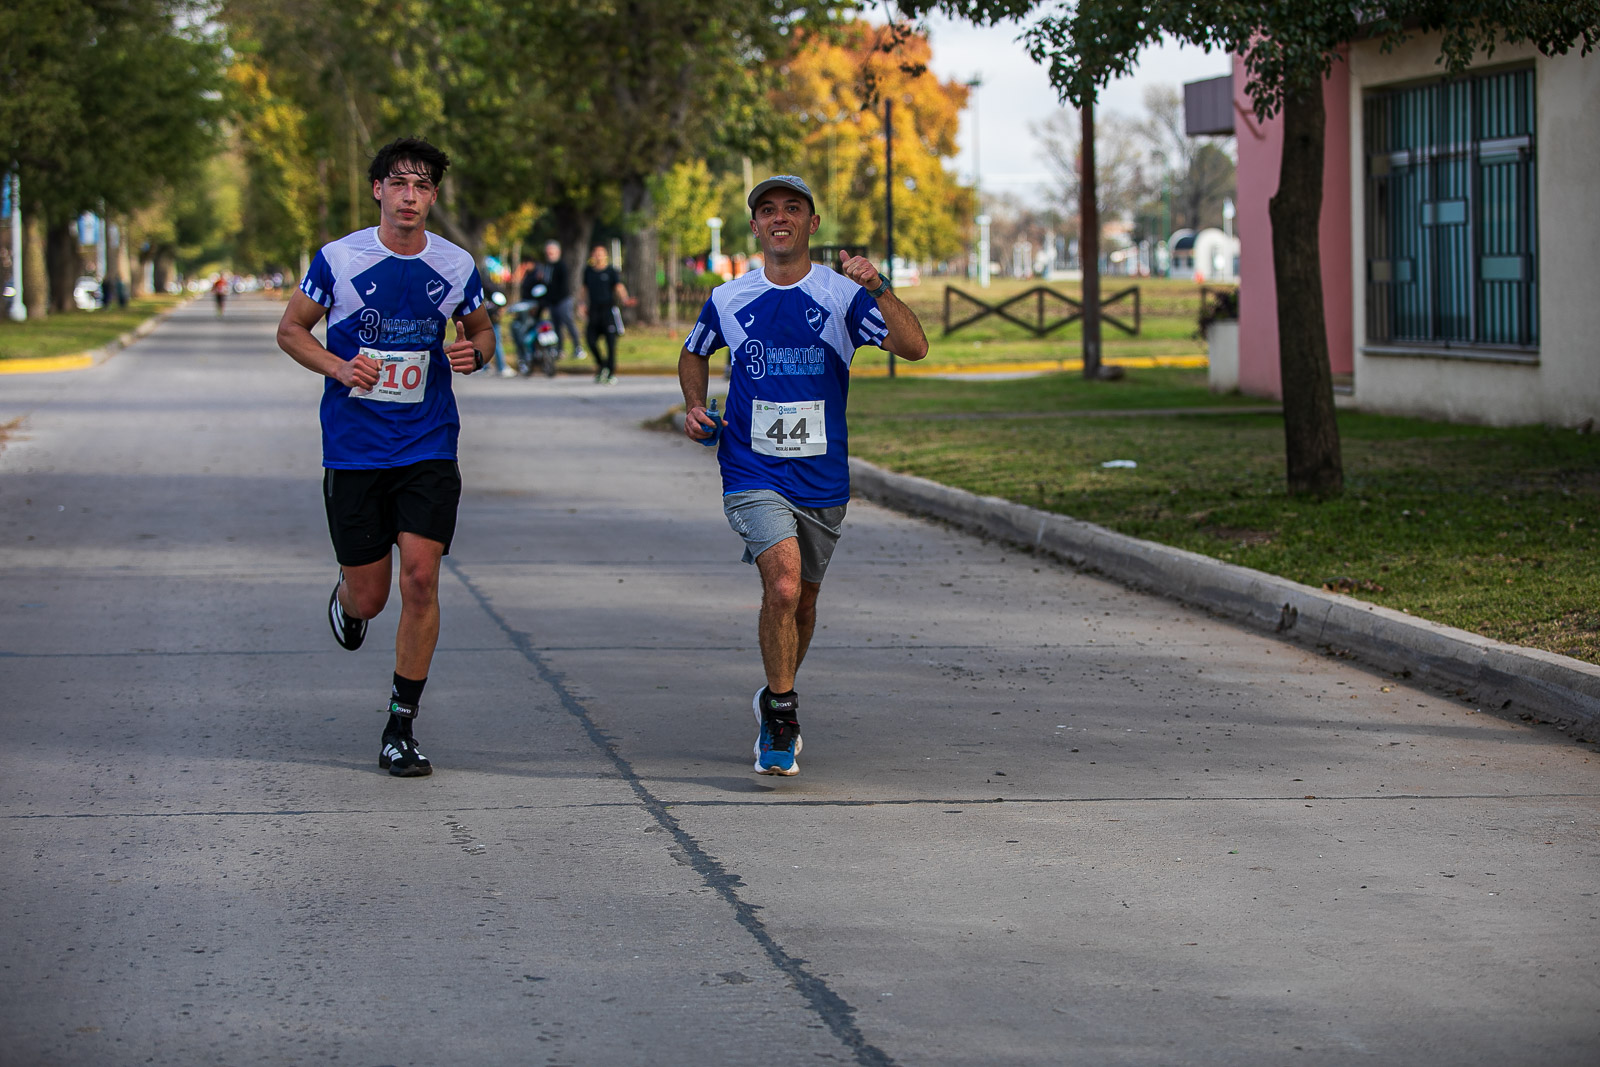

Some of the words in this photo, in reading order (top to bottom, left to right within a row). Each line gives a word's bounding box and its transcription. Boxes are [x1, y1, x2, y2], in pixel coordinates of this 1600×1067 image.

[358, 308, 381, 345] 3
[745, 339, 766, 380] 3
[766, 344, 825, 364] MARATÓN
[376, 363, 422, 390] 10
[766, 417, 810, 444] 44
